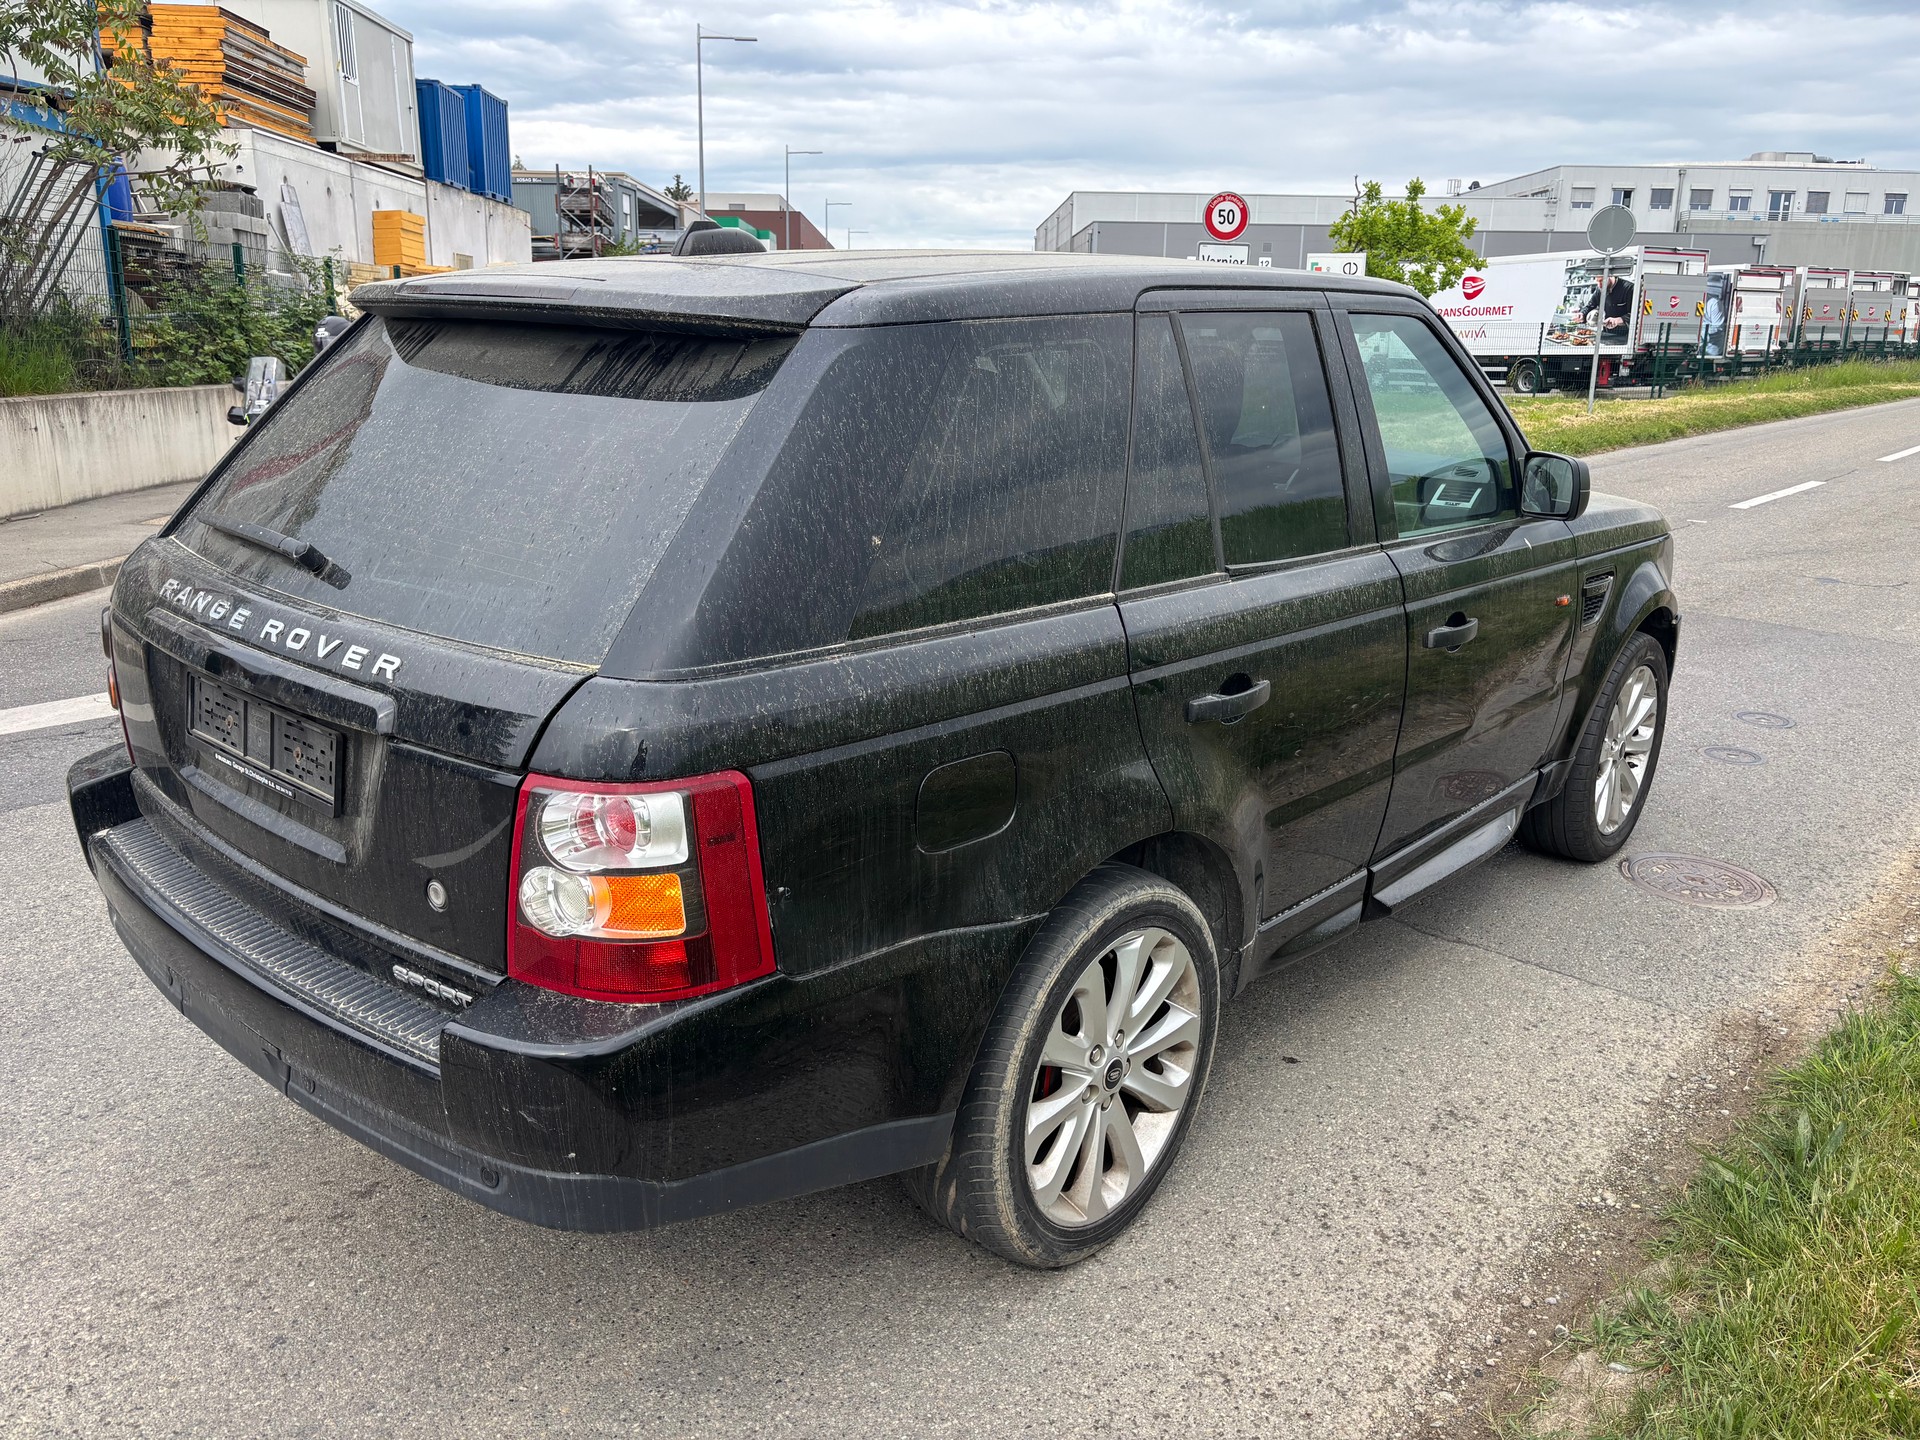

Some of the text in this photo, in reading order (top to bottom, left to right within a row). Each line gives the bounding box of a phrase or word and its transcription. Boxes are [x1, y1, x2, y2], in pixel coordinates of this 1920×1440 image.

[1209, 196, 1225, 209] Limite
[1218, 209, 1235, 225] 50
[1437, 305, 1514, 318] RANSGOURMET
[158, 578, 404, 680] RANGE ROVER
[392, 964, 473, 1009] SPORT
